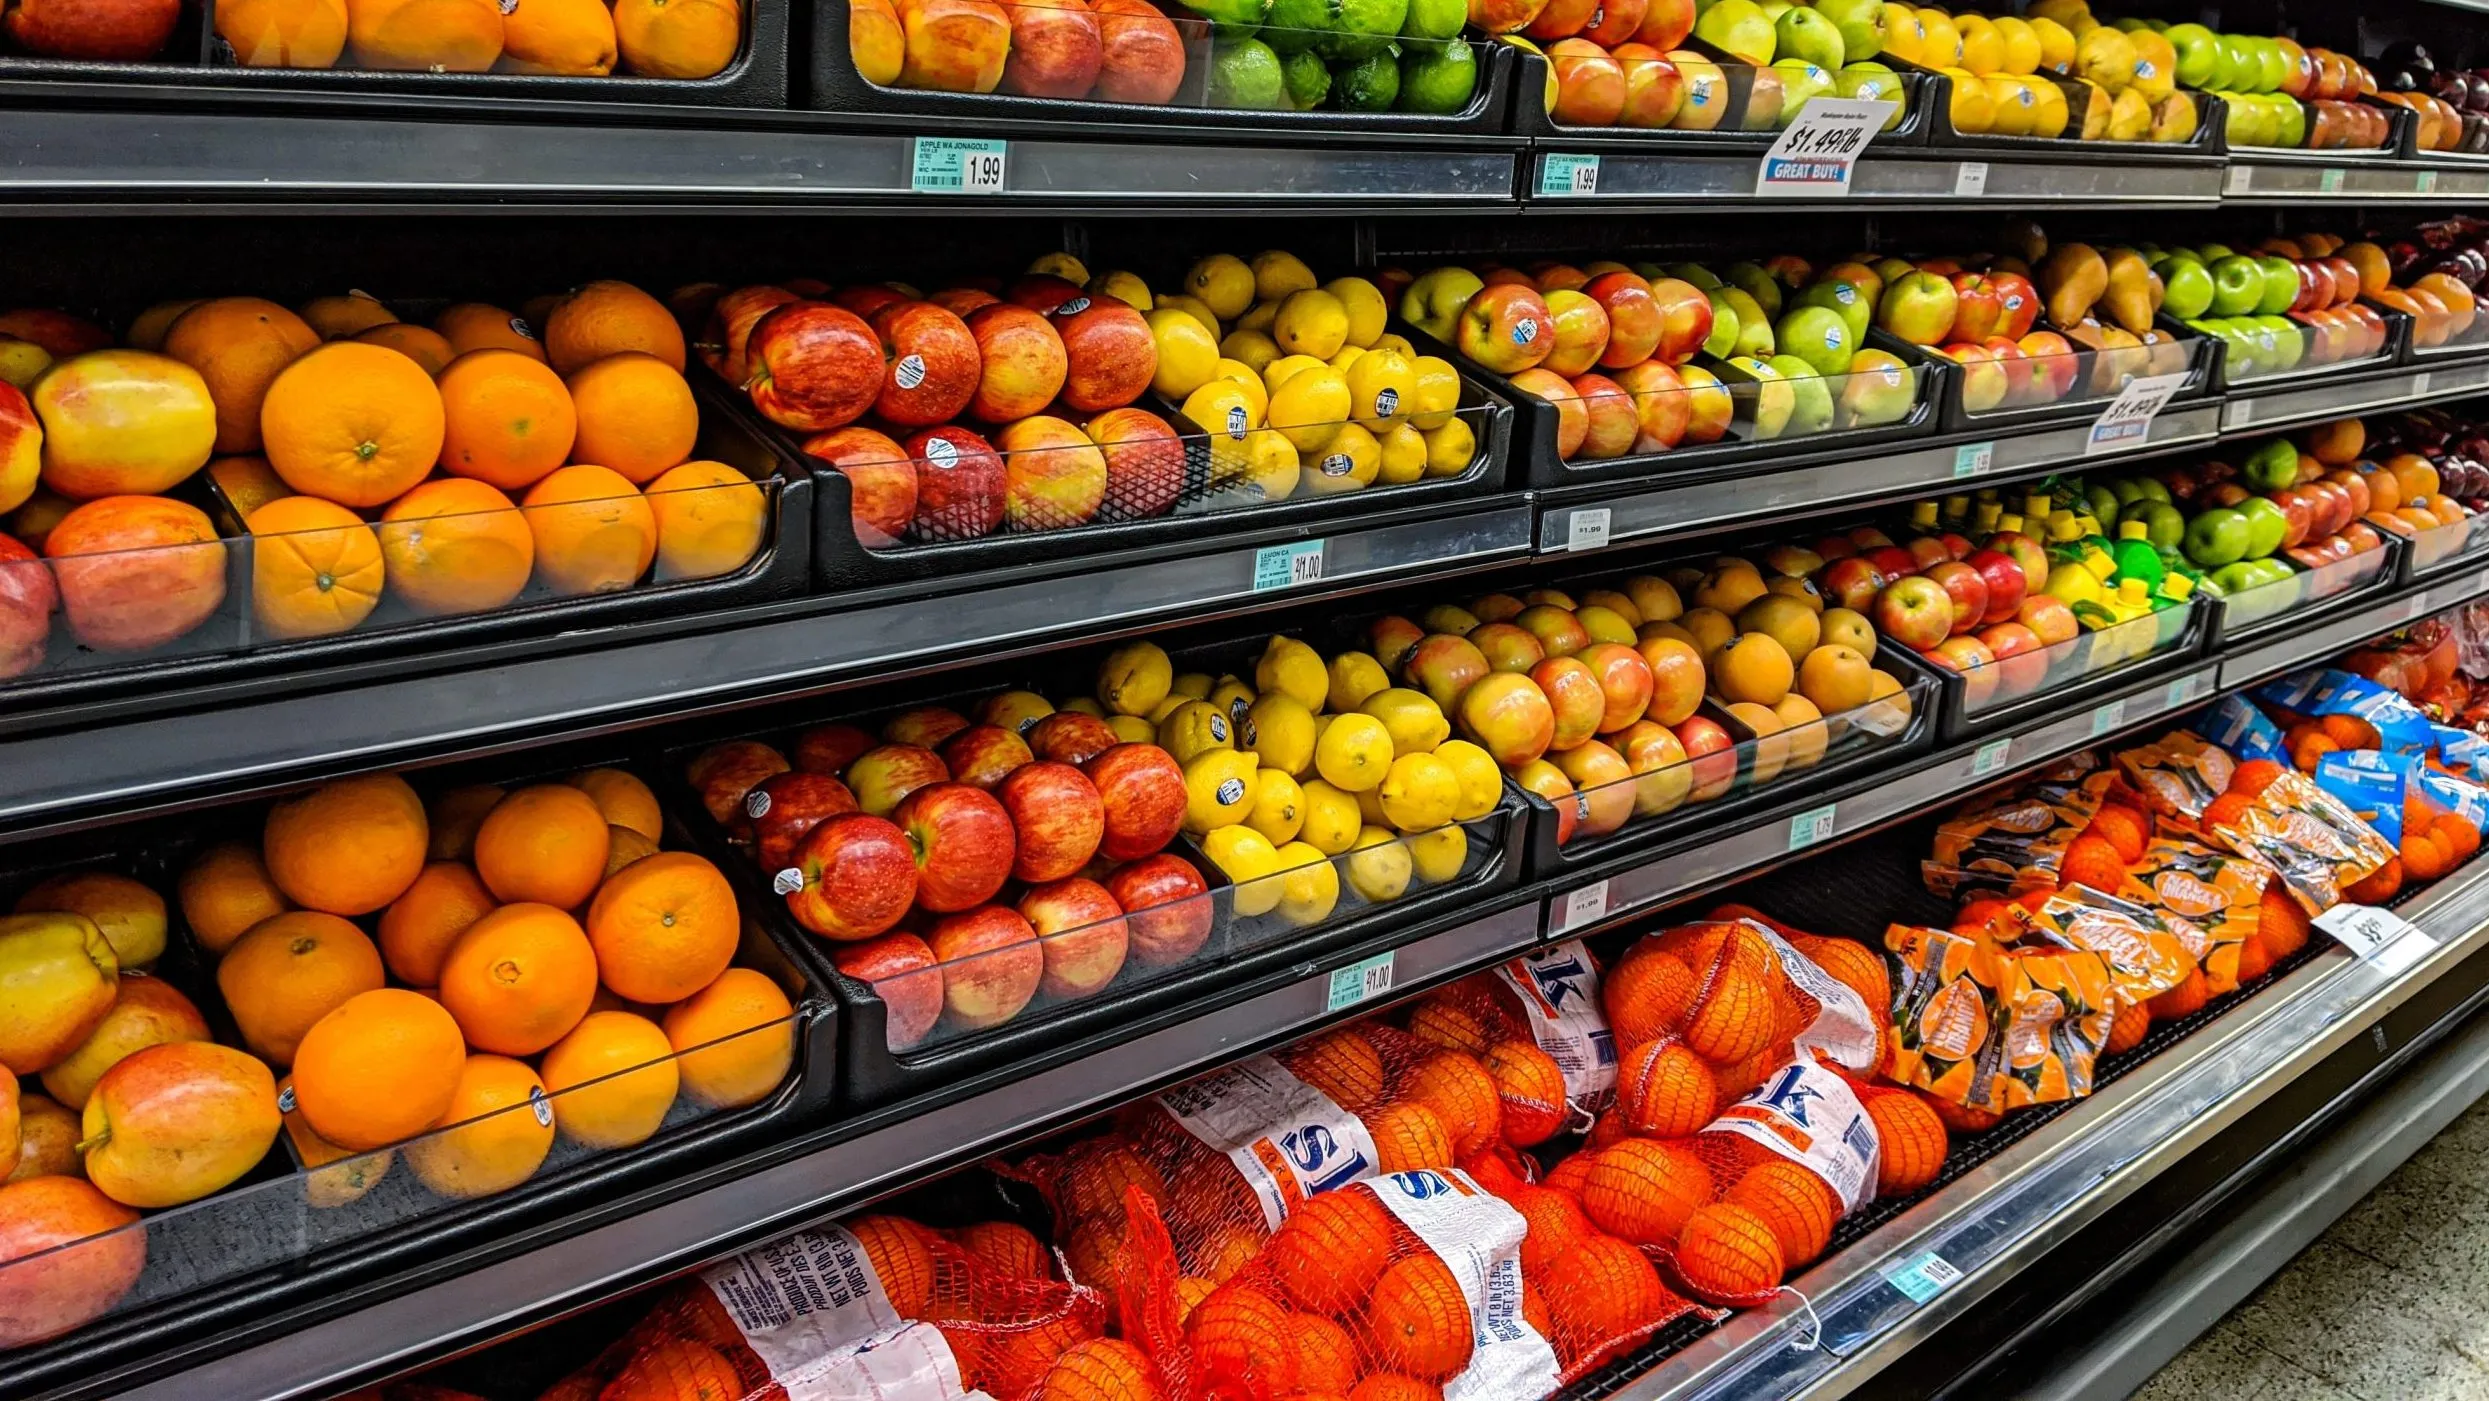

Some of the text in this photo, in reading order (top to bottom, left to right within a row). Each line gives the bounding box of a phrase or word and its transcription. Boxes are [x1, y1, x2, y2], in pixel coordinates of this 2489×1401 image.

[954, 142, 989, 150] JONAGOLD
[970, 156, 1000, 185] 1.99
[1576, 168, 1595, 190] 1.99
[1774, 163, 1839, 179] GREAT BUY!
[1579, 525, 1602, 534] $1.99
[1261, 551, 1281, 559] LEMON
[790, 1253, 809, 1273] DES
[836, 1250, 858, 1271] NET
[1502, 1260, 1514, 1272] kg
[772, 1266, 793, 1279] OF
[820, 1270, 843, 1291] WT
[845, 1266, 871, 1298] POIDS
[800, 1274, 830, 1311] PRODUIT
[1502, 1274, 1515, 1297] 3.63
[779, 1276, 813, 1316] PRODUCE
[829, 1285, 852, 1308] NET
[1489, 1292, 1502, 1302] lb
[1502, 1299, 1515, 1317] NET
[1487, 1311, 1501, 1330] WT
[1493, 1327, 1513, 1342] NET
